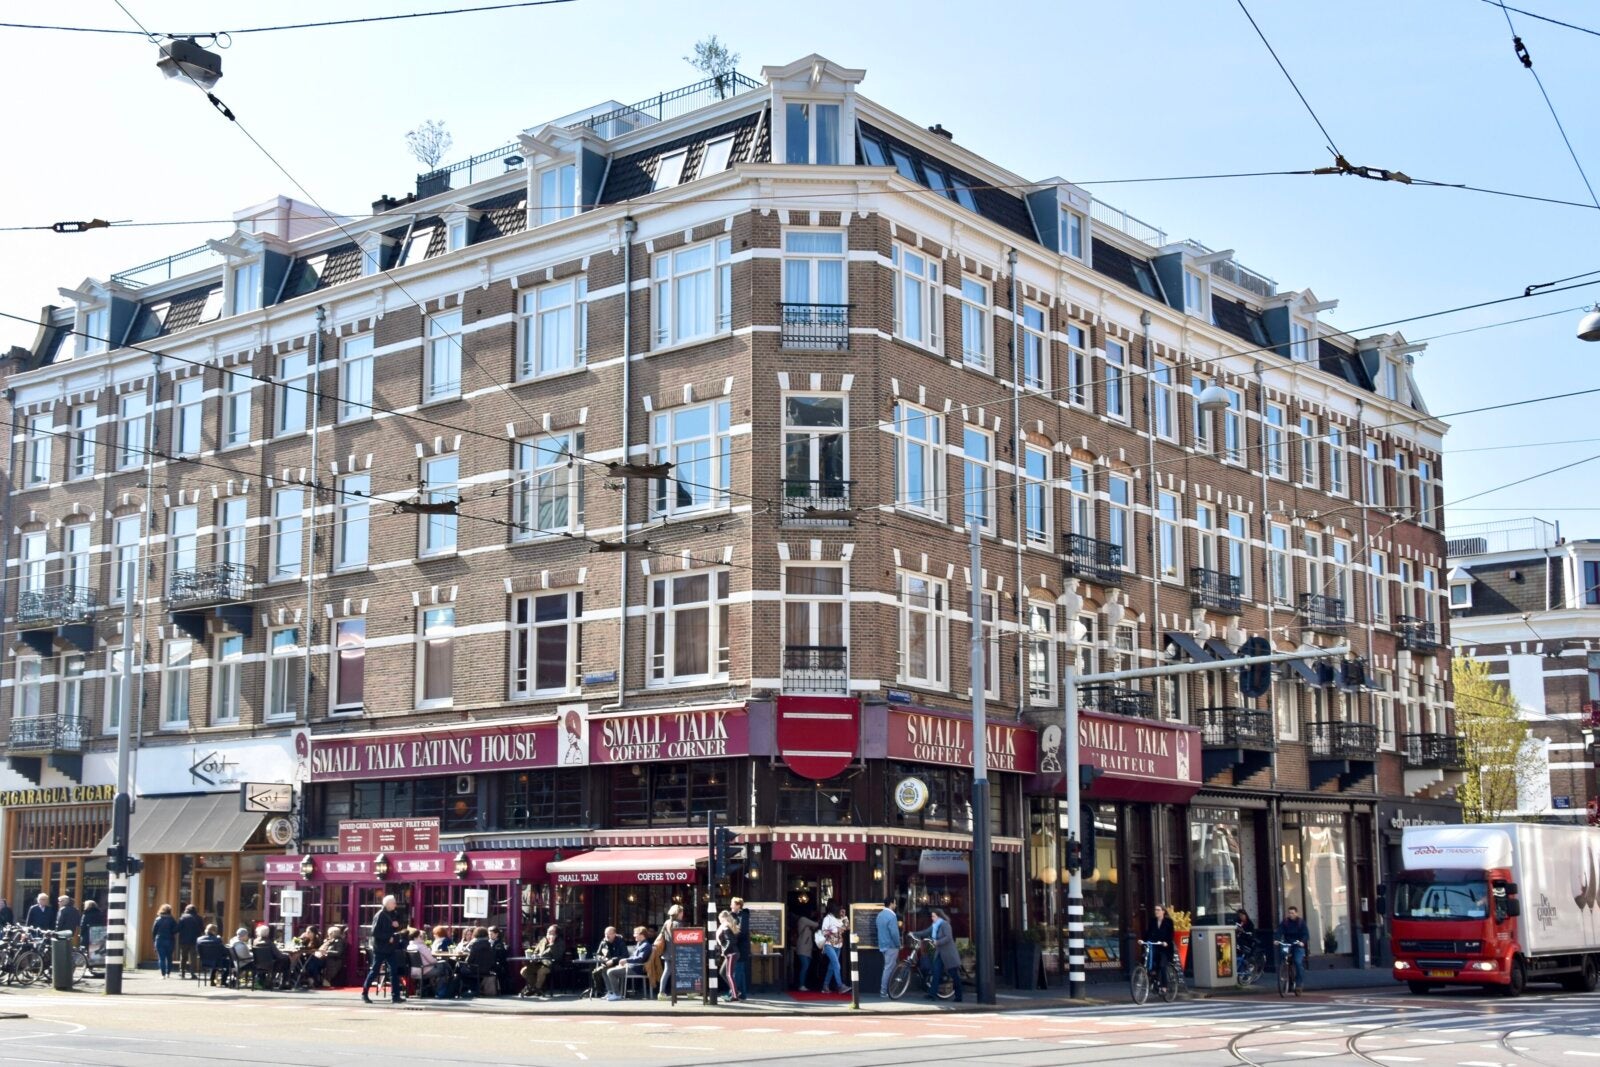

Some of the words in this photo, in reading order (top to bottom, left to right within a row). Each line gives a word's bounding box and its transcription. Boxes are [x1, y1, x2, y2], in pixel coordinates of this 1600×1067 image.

[603, 715, 666, 747] SMALL
[675, 711, 729, 742] TALK
[907, 714, 965, 749] SMALL
[985, 725, 1016, 755] ALK
[1080, 720, 1127, 752] SMALL
[1135, 728, 1169, 757] TALK
[312, 747, 361, 774] SMALL
[365, 742, 405, 770] TALK
[412, 738, 472, 768] EATING
[480, 733, 537, 763] HOUSE
[610, 744, 661, 761] COFFEE
[668, 740, 726, 758] CORNER
[913, 744, 962, 764] COFFEE
[968, 750, 1015, 770] CRNER
[558, 874, 579, 882] SMALL
[581, 873, 599, 881] TALK
[637, 872, 664, 881] COFFEE
[666, 872, 675, 880] TO
[676, 872, 688, 880] GO
